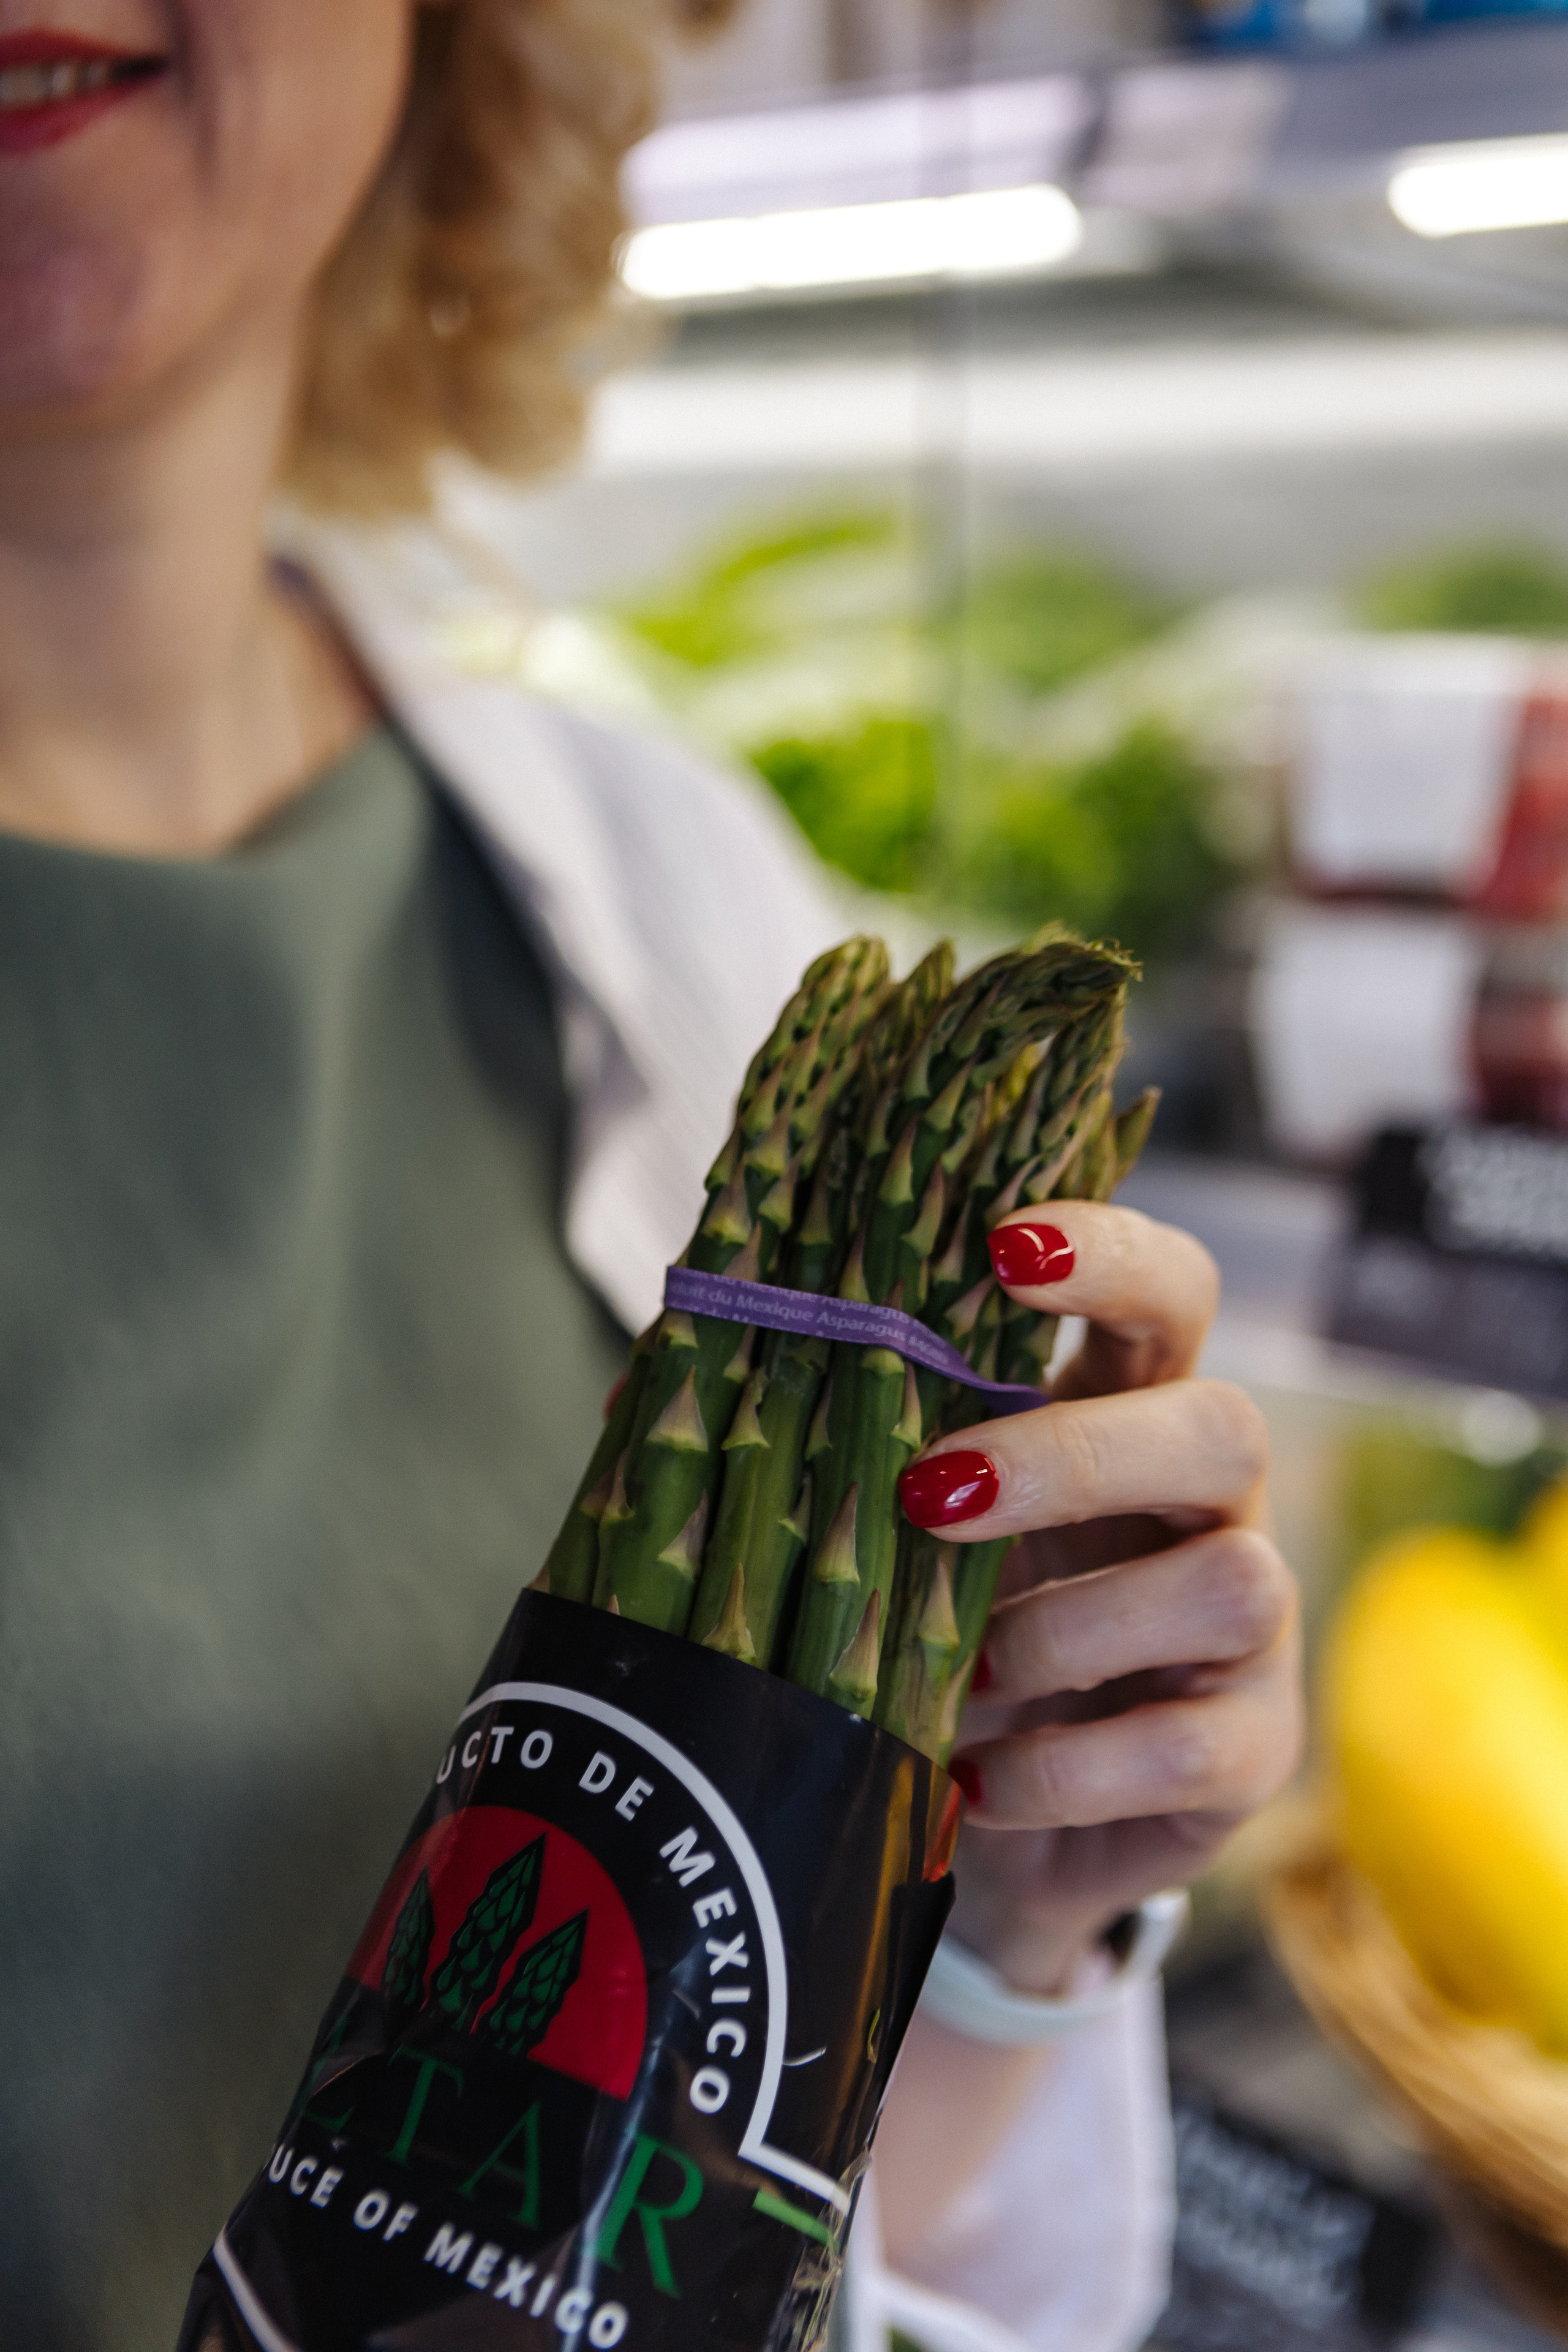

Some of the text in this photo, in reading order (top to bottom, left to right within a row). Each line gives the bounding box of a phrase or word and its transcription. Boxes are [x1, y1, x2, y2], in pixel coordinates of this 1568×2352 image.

[708, 1287, 733, 1305] du
[736, 1293, 814, 1323] Mexique
[815, 1310, 907, 1343] Asparagus
[578, 1751, 654, 1822] DE
[658, 1826, 751, 2114] MEXICO
[265, 2143, 630, 2350] UCE OF MEXICO
